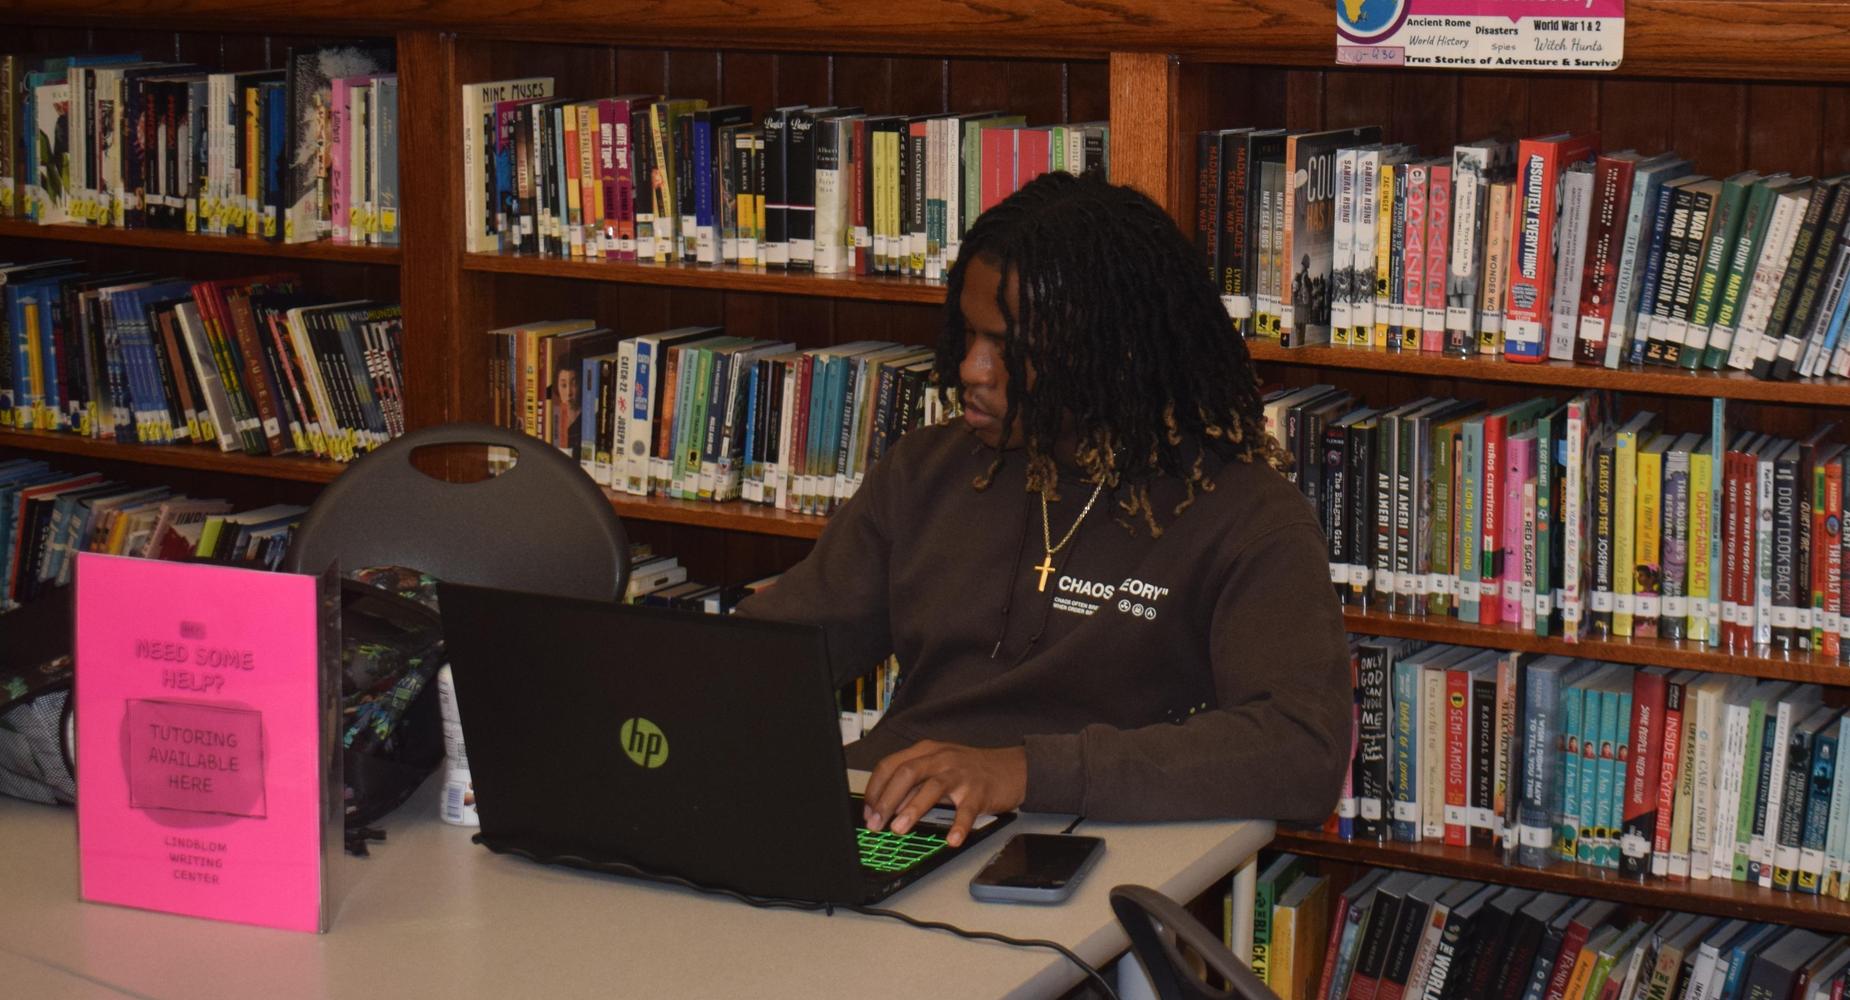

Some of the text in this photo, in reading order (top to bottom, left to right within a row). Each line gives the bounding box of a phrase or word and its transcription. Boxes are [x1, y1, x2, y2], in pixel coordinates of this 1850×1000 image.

[1407, 18, 1471, 28] Ancient Rome
[1475, 26, 1519, 36] Disasters
[1534, 20, 1601, 32] World War 1 2
[1409, 36, 1469, 48] World History
[1491, 42, 1516, 52] Spies
[1534, 38, 1568, 52] Witch
[1406, 55, 1570, 67] True Stories of Adventure &
[482, 82, 545, 102] NINE MUSES
[1342, 160, 1352, 223] SAMURAI RISING
[1362, 160, 1373, 225] SAMURAI RISING
[1382, 176, 1390, 189] ZAC
[1527, 154, 1545, 215] ABSOLUTELY
[1670, 208, 1689, 238] WAR
[1688, 210, 1708, 240] WAR
[1522, 218, 1540, 279] EVERYTHING!
[1488, 254, 1498, 294] WONDER
[1618, 235, 1637, 304] THE WHYDAH
[1658, 252, 1680, 300] SEBASTIAN
[1677, 254, 1698, 303] SEBASTIAN
[1700, 236, 1725, 301] GRUNT MARY
[1726, 238, 1752, 303] GRUNT MARY
[616, 356, 629, 445] CATCH-22 JOSEPH
[1488, 442, 1497, 471] NIÑOS
[1378, 473, 1389, 488] AN
[1398, 474, 1409, 491] AN
[1677, 480, 1686, 498] THE
[1728, 479, 1737, 503] WORK
[1744, 482, 1752, 506] WORK
[1332, 472, 1343, 556] The Enigma Girls
[1598, 455, 1609, 583] FEARLESS AND FREE JOSEPHINE
[1664, 494, 1673, 542] BESTIARY
[1728, 512, 1736, 535] WHAT
[1743, 516, 1751, 539] WHAT
[1464, 488, 1473, 571] LONG TIME COMING
[1694, 491, 1708, 591] DISAPPEARING ACT
[1776, 487, 1793, 600] DON'T LOOK BACK
[1524, 520, 1533, 577] RED SCARF
[1829, 544, 1841, 594] THE SALT
[1058, 576, 1115, 601] CHAOS
[136, 639, 255, 671] NEED SOME
[162, 670, 225, 694] HELP?
[1361, 670, 1383, 686] GOD
[1362, 711, 1383, 726] ME
[1400, 702, 1411, 735] DIARY
[1530, 719, 1537, 732] TO
[149, 724, 239, 749] TUTORING
[629, 717, 662, 768] hp
[1400, 736, 1408, 746] OF
[1450, 709, 1463, 784] SEMI-FAMOUS
[1481, 706, 1490, 773] RADICAL BY
[1528, 733, 1536, 756] TELL
[149, 746, 240, 773] AVAILABLE
[1634, 704, 1650, 804] SOME PEOPLE NEED KILLING
[1660, 716, 1678, 806] INSIDE EGYPT
[1683, 722, 1696, 796] LIFE AS POLITICS
[168, 774, 214, 793] HERE
[1526, 779, 1535, 799] THIS
[1534, 782, 1543, 807] HAVE
[1695, 760, 1710, 844] CASE ISRAEL
[164, 836, 227, 853] LINDBLOM
[169, 853, 223, 869] WRITING
[172, 870, 220, 886] CENTER
[1252, 918, 1267, 962] BLACK
